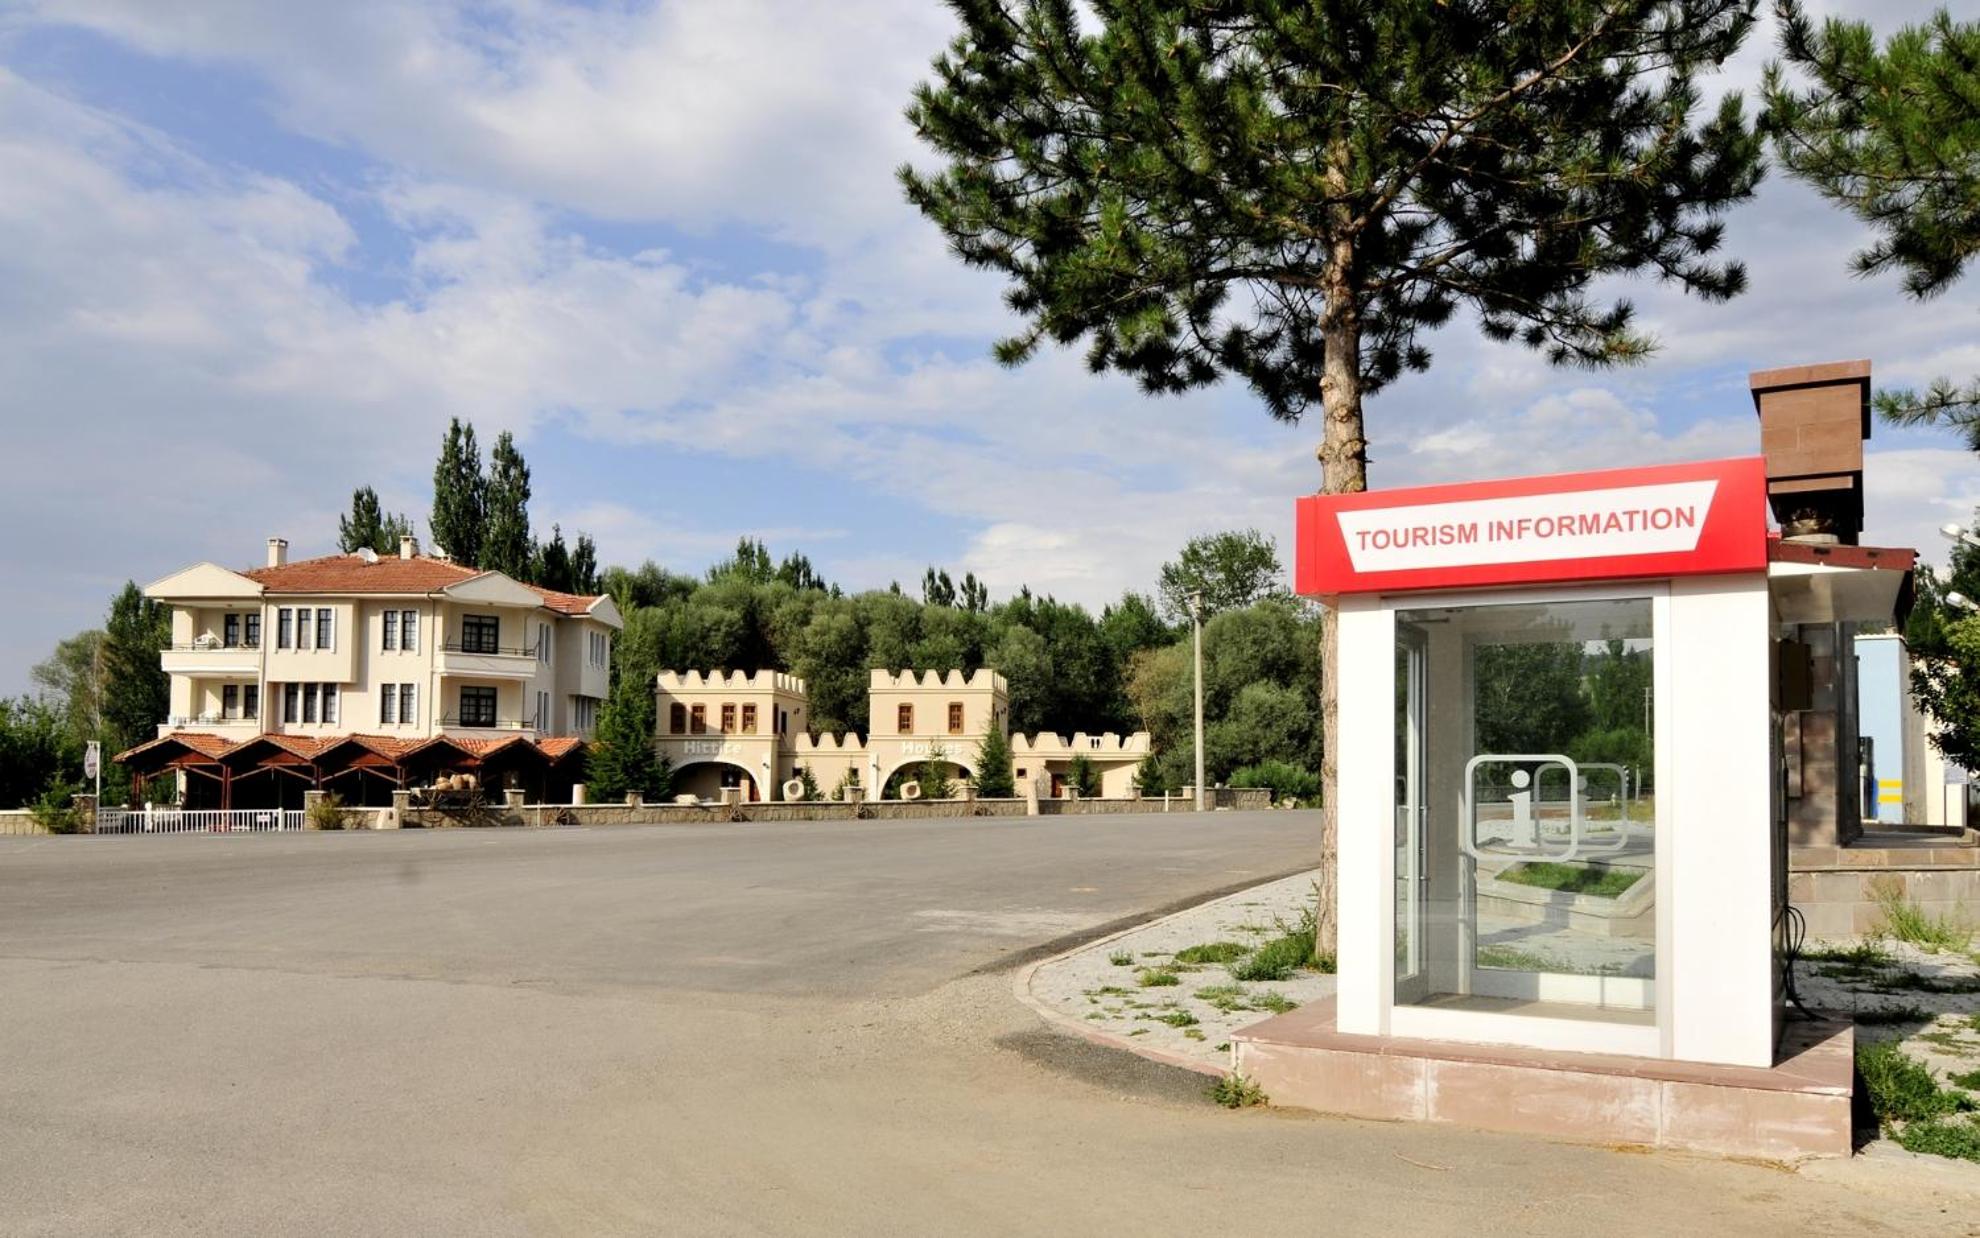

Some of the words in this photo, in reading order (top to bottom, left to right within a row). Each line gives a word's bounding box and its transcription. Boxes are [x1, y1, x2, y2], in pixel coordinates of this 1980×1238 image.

[1356, 523, 1478, 550] TOURISM
[1488, 506, 1696, 542] INFORMATION
[684, 741, 742, 754] Hittite
